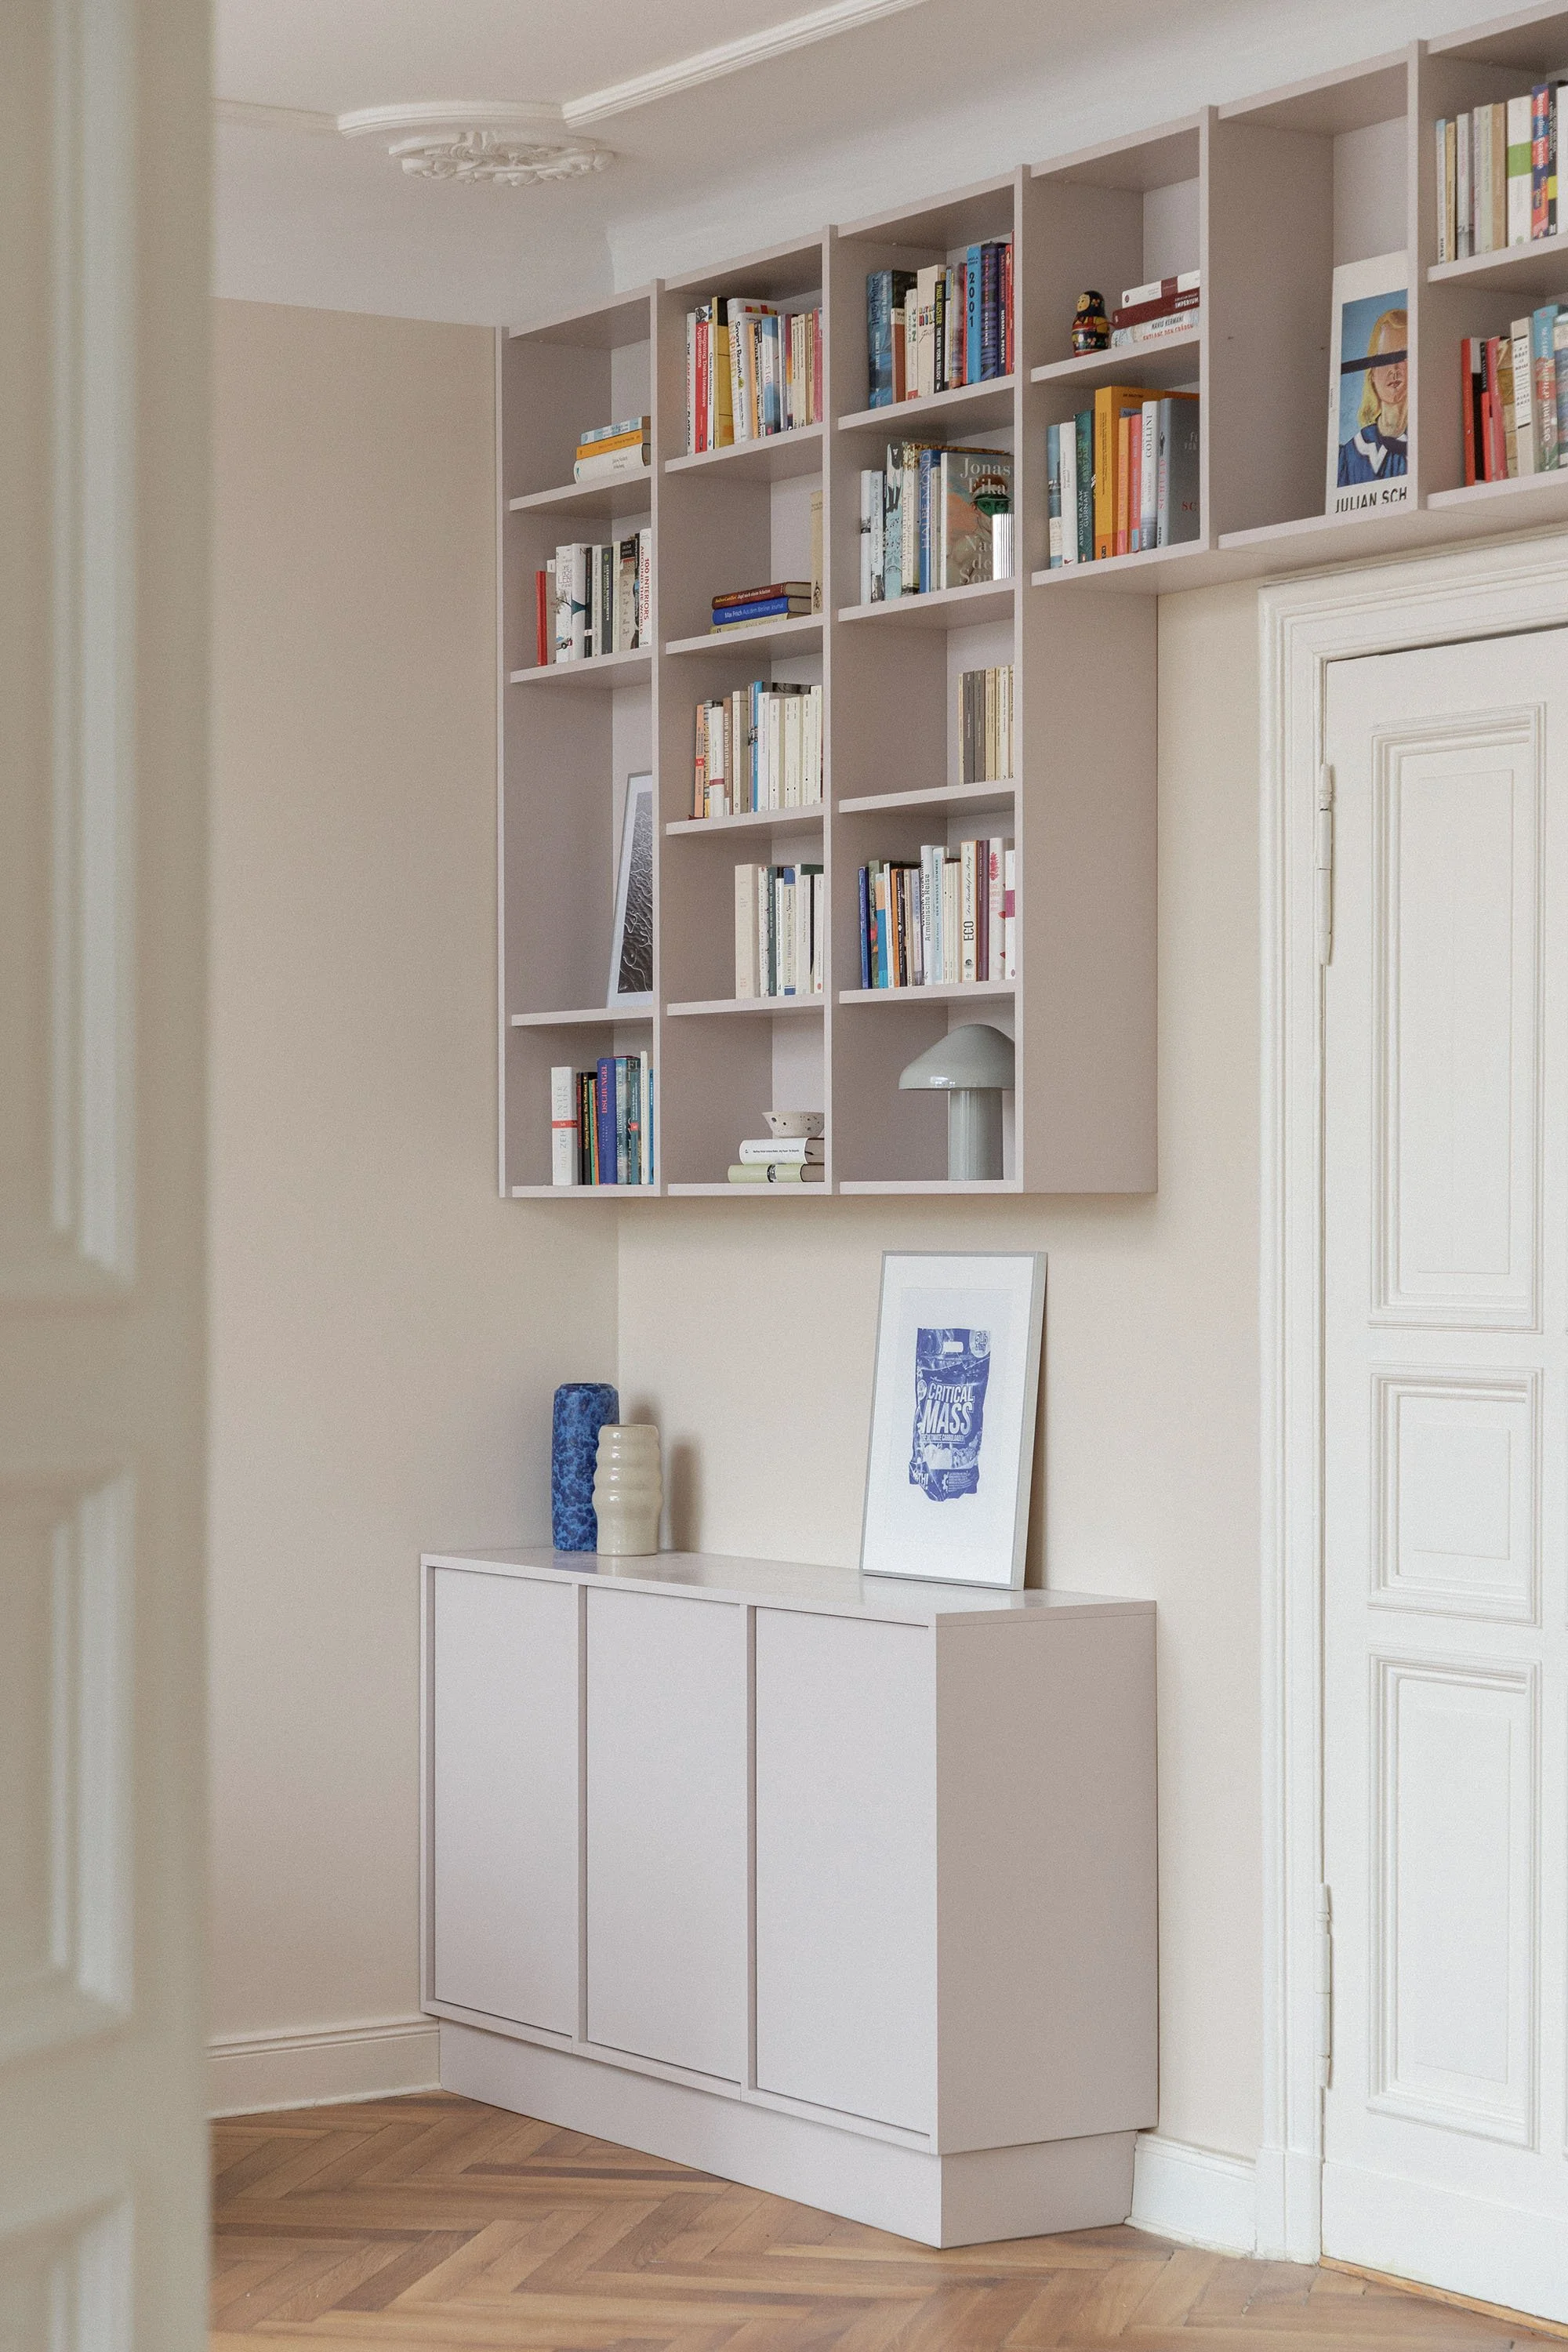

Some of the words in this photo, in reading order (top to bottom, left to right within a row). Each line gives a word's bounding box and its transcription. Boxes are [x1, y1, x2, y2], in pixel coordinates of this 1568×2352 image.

[1175, 297, 1198, 308] IMPERIUM
[922, 452, 931, 499] MOND
[960, 457, 1011, 478] Jonas
[969, 478, 1005, 495] Eika
[1335, 492, 1377, 514] JULIAN
[1381, 486, 1407, 505] SCH
[964, 920, 974, 941] ECO
[927, 1382, 975, 1403] CRITICAL
[923, 1400, 975, 1436] MASS
